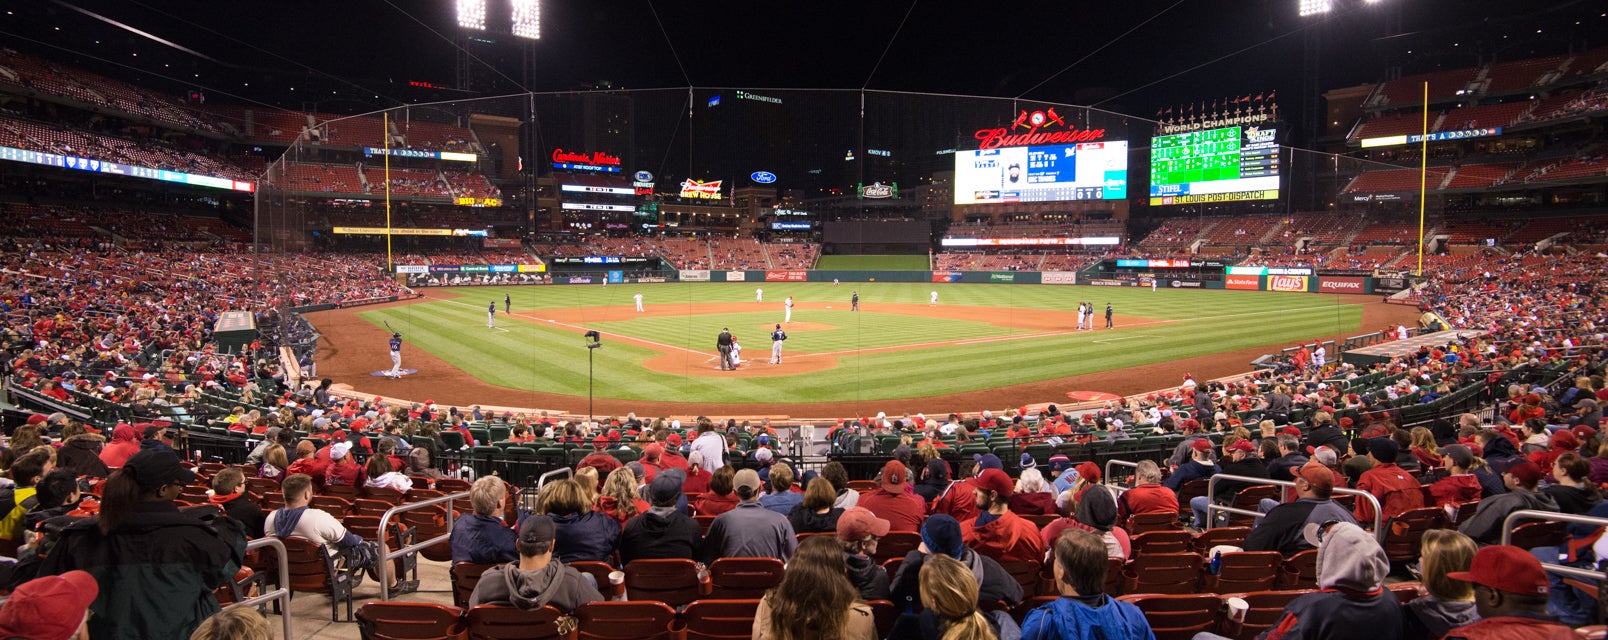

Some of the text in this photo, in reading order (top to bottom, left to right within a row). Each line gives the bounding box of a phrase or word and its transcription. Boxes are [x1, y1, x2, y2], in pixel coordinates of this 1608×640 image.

[744, 92, 782, 104] GREENSFELDER
[1164, 114, 1268, 134] WORLD CHAMPIONS
[975, 124, 1105, 150] Budweiser
[1411, 133, 1436, 142] THAT'S
[552, 148, 620, 165] Cardinals Nation
[756, 172, 772, 182] Ford
[866, 187, 888, 196] Coca-Cola
[1158, 184, 1182, 193] STIFEL
[1077, 191, 1083, 199] 0
[1087, 190, 1092, 199] 1
[1096, 190, 1102, 198] 0
[1186, 194, 1206, 203] LOUIS
[1208, 191, 1264, 202] POST-DISPATCH
[459, 198, 475, 206] BIG
[1273, 276, 1304, 290] Lay's
